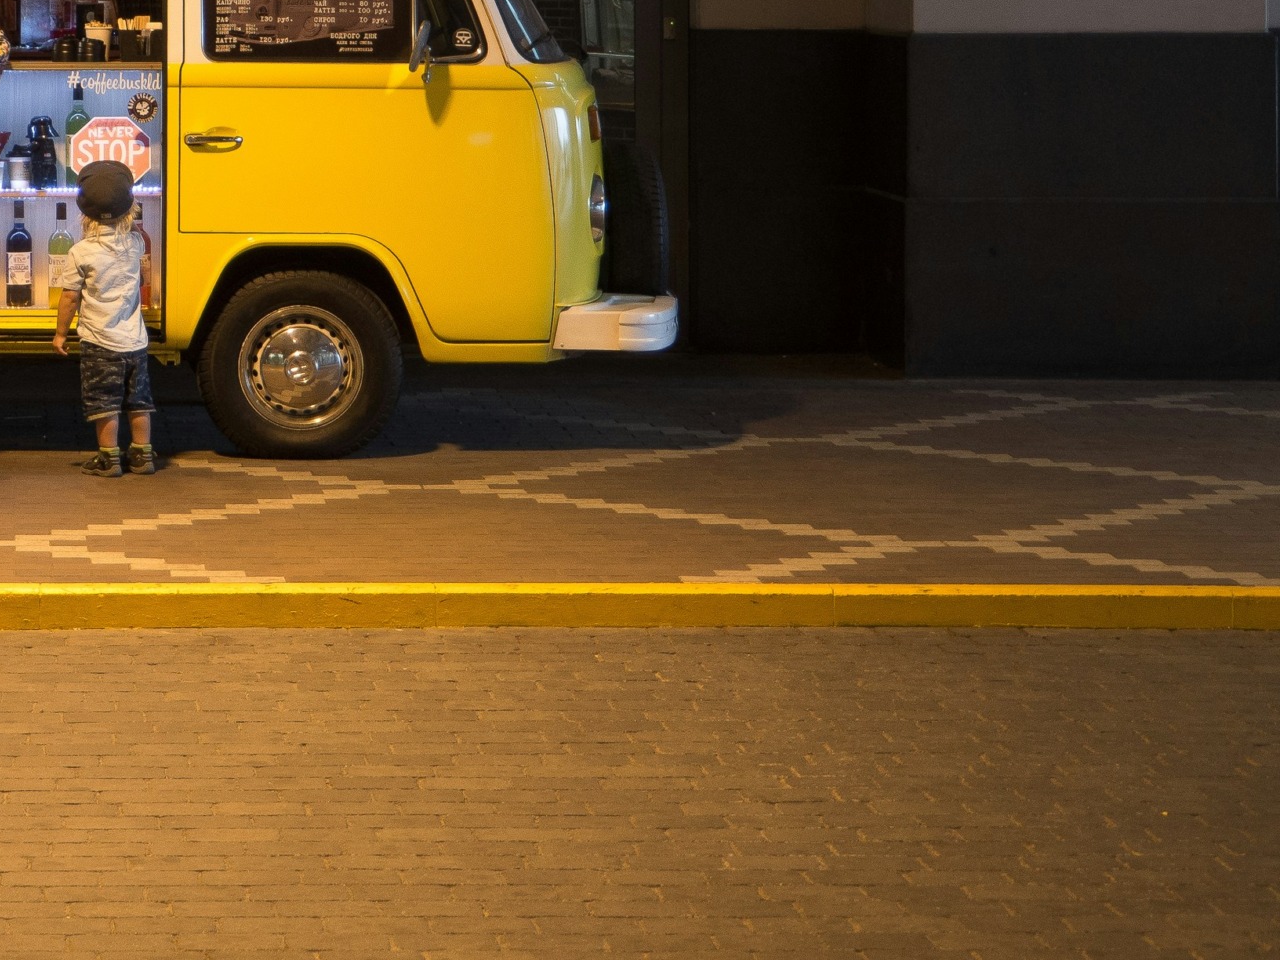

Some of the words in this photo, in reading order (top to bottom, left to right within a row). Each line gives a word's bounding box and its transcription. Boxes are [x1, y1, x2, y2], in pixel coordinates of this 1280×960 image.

[67, 71, 161, 95] #coffeebuskld
[88, 126, 134, 139] NEVER
[77, 139, 145, 167] STOP
